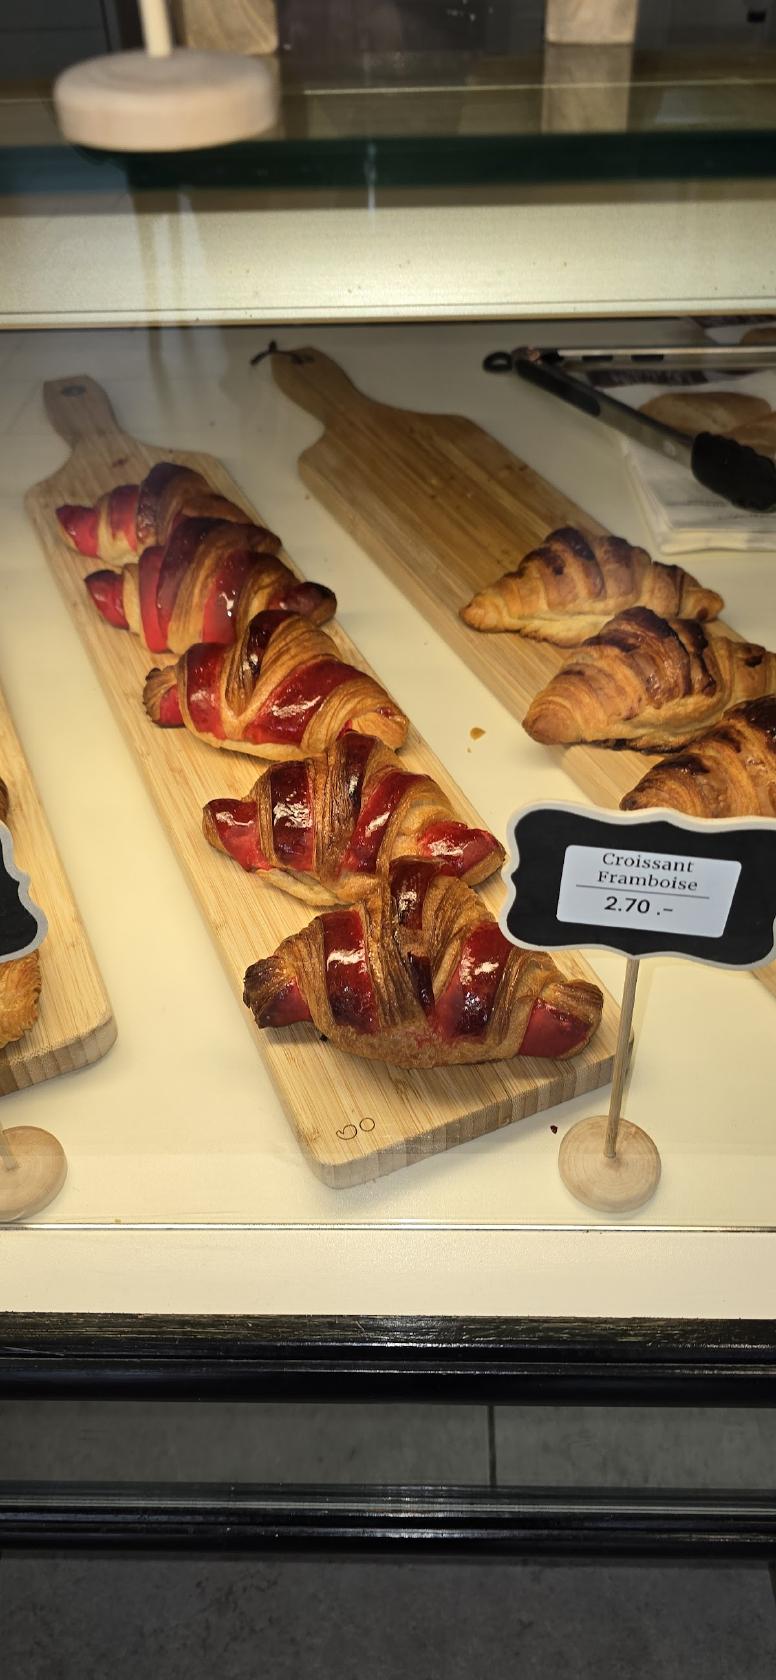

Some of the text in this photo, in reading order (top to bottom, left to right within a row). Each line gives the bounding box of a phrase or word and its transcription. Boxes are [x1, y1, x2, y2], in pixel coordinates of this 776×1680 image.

[602, 852, 694, 872] Croissant
[597, 870, 698, 891] Framboise
[604, 896, 650, 914] 2.70
